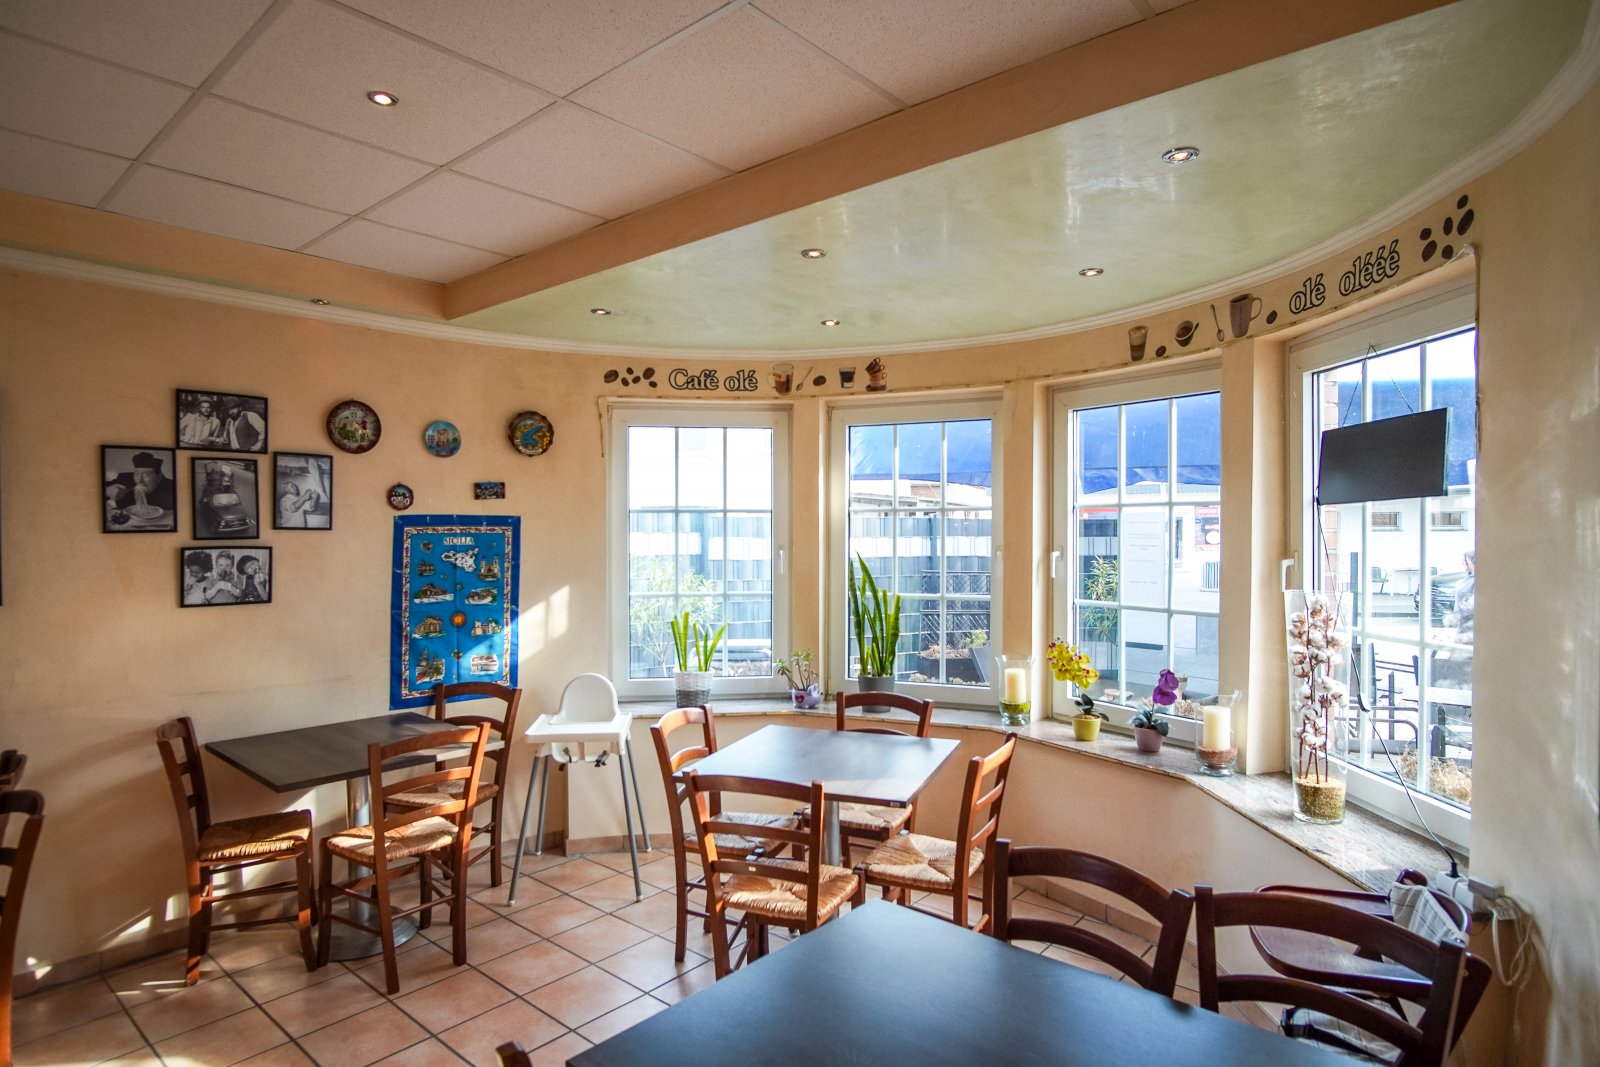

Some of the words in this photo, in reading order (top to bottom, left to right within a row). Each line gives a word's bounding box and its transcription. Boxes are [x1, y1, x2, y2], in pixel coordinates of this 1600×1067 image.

[1289, 273, 1325, 314] olé
[1339, 239, 1400, 296] olééé
[668, 368, 719, 391] Café
[724, 369, 758, 392] olé
